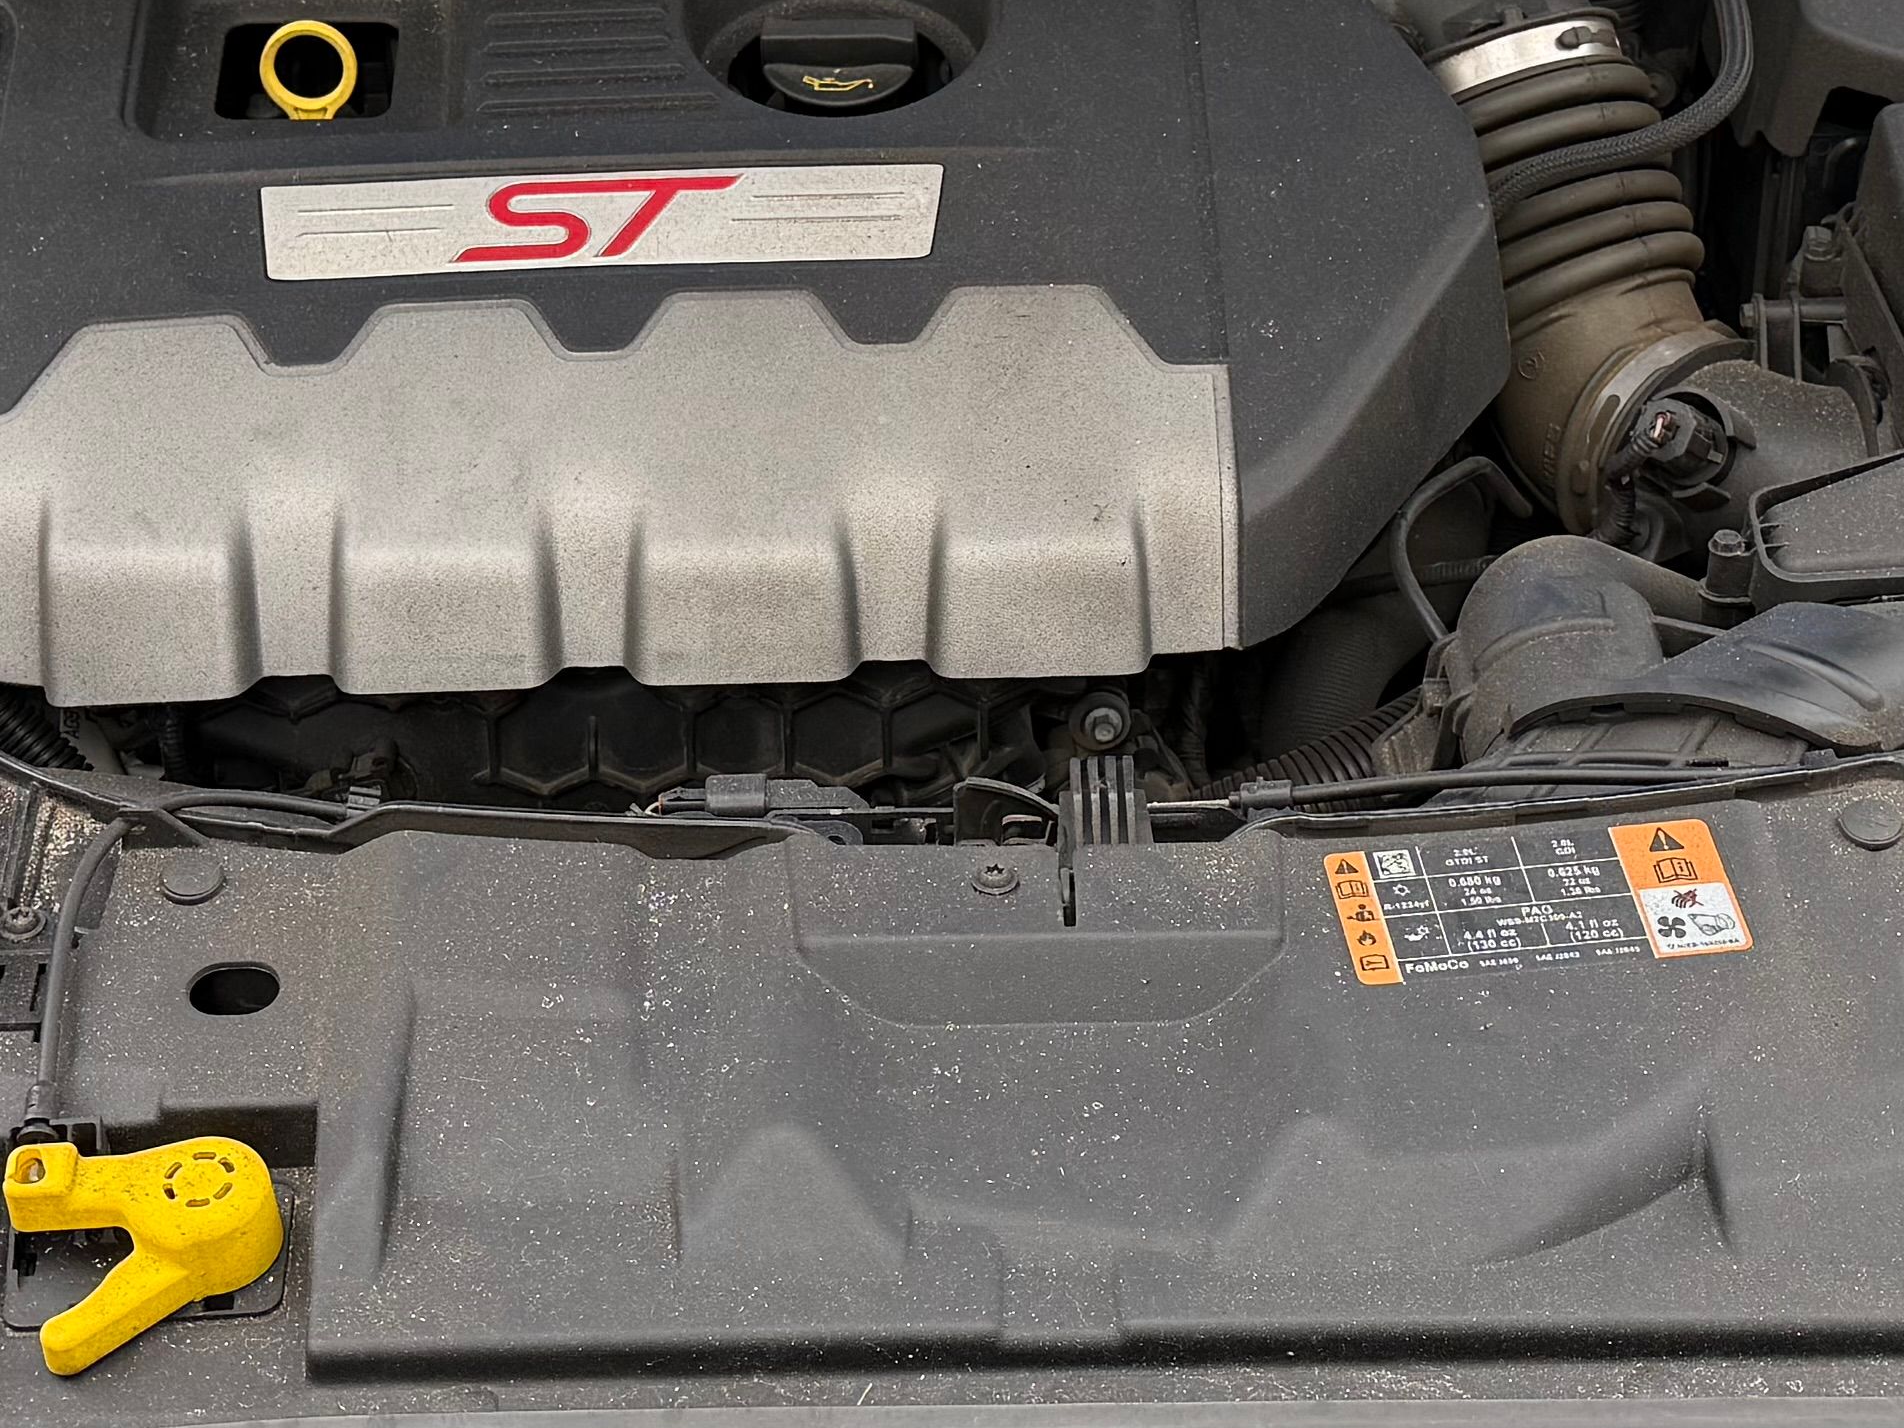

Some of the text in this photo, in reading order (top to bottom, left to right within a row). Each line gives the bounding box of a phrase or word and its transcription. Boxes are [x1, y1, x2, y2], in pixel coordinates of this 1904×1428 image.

[449, 172, 746, 264] ST
[1583, 865, 1601, 877] kg
[1484, 875, 1502, 887] kg
[1565, 920, 1586, 931] 4.1
[1602, 919, 1619, 928] oz
[1463, 930, 1484, 940] 4.4
[1500, 928, 1518, 937] oz
[1570, 927, 1624, 943] (120 cc)
[1467, 937, 1522, 952] (130 cc)
[1405, 959, 1470, 974] FoMoCo
